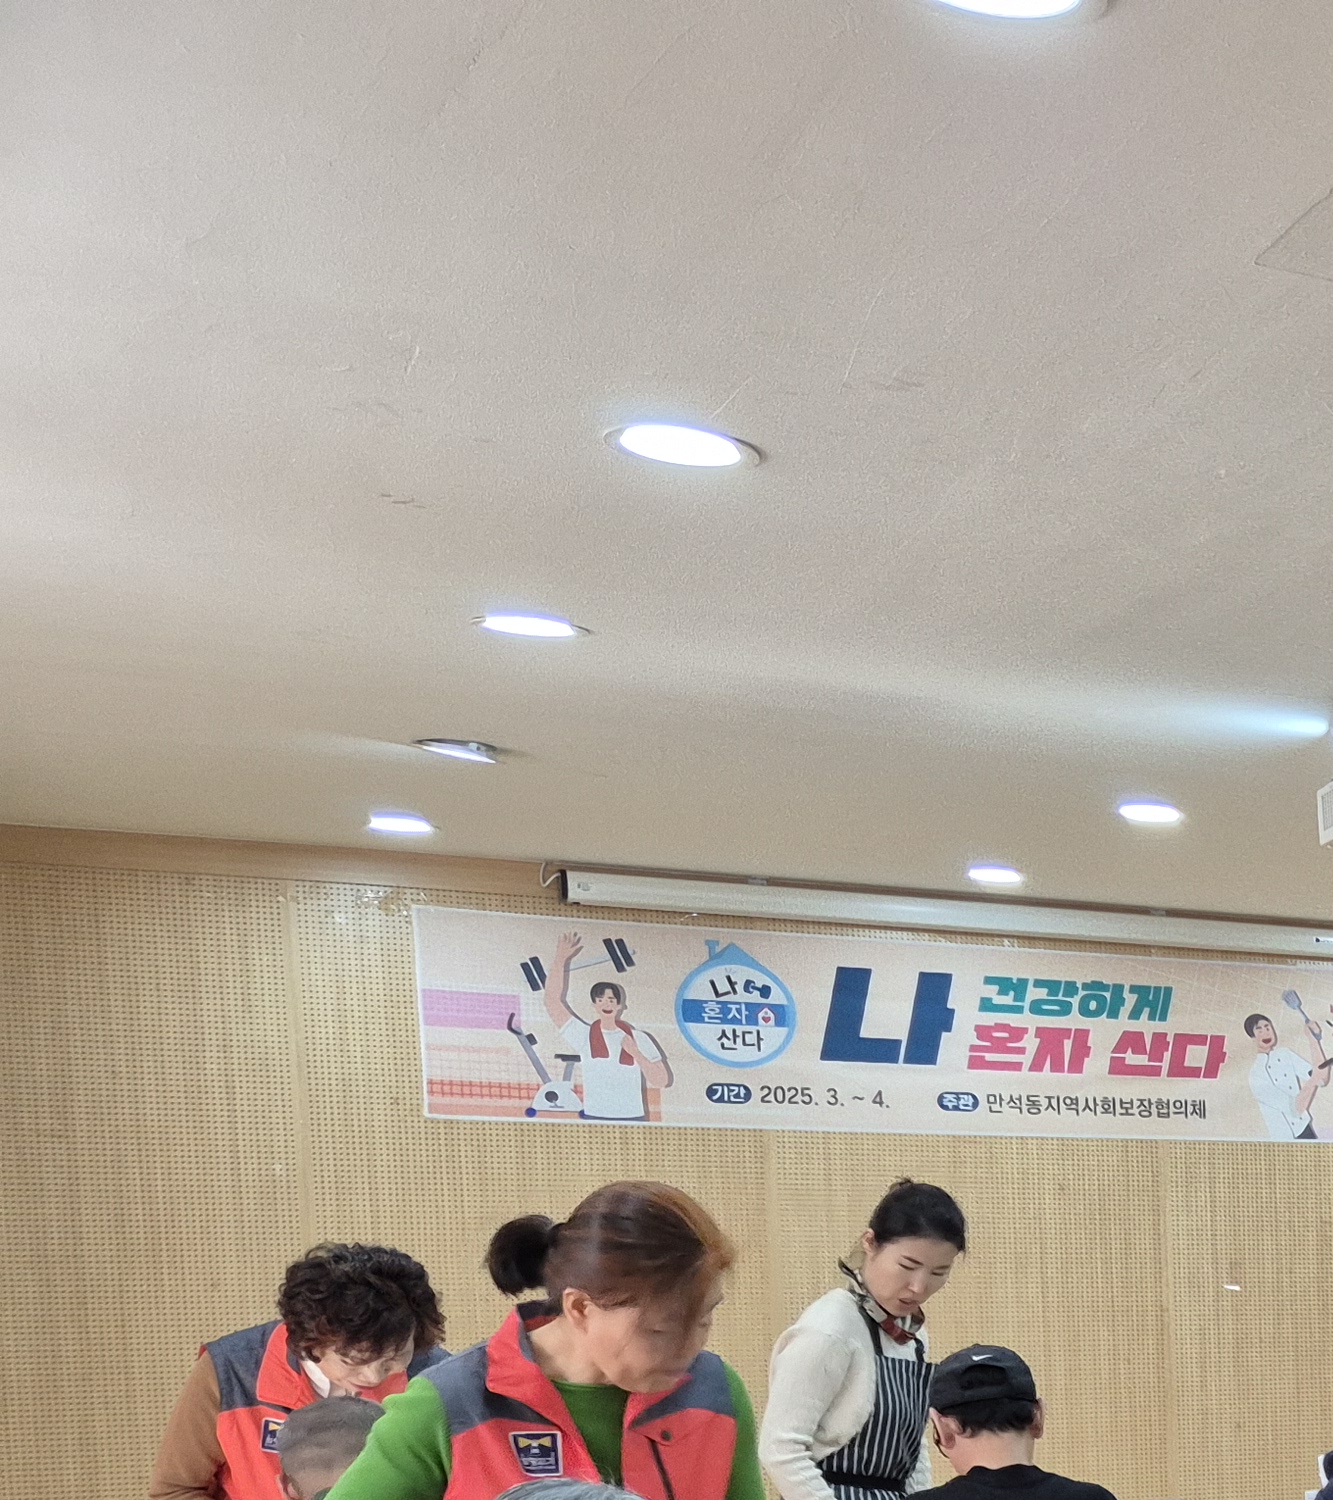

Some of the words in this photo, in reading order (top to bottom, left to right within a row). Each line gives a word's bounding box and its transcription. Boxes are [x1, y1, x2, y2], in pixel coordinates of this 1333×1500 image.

[709, 974, 738, 998] 나
[978, 975, 1174, 1022] 건강하게
[701, 1002, 749, 1024] 혼자
[819, 966, 955, 1066] 나
[717, 1028, 764, 1052] 산다
[966, 1022, 1092, 1074] 혼자
[1107, 1030, 1228, 1080] 산다
[711, 1085, 746, 1102] 기간
[759, 1085, 819, 1106] 2025.
[826, 1087, 845, 1107] 3.
[871, 1089, 890, 1109] 4.
[941, 1093, 975, 1111] 주관
[986, 1092, 1207, 1120] 만석동지역사회보장협의체
